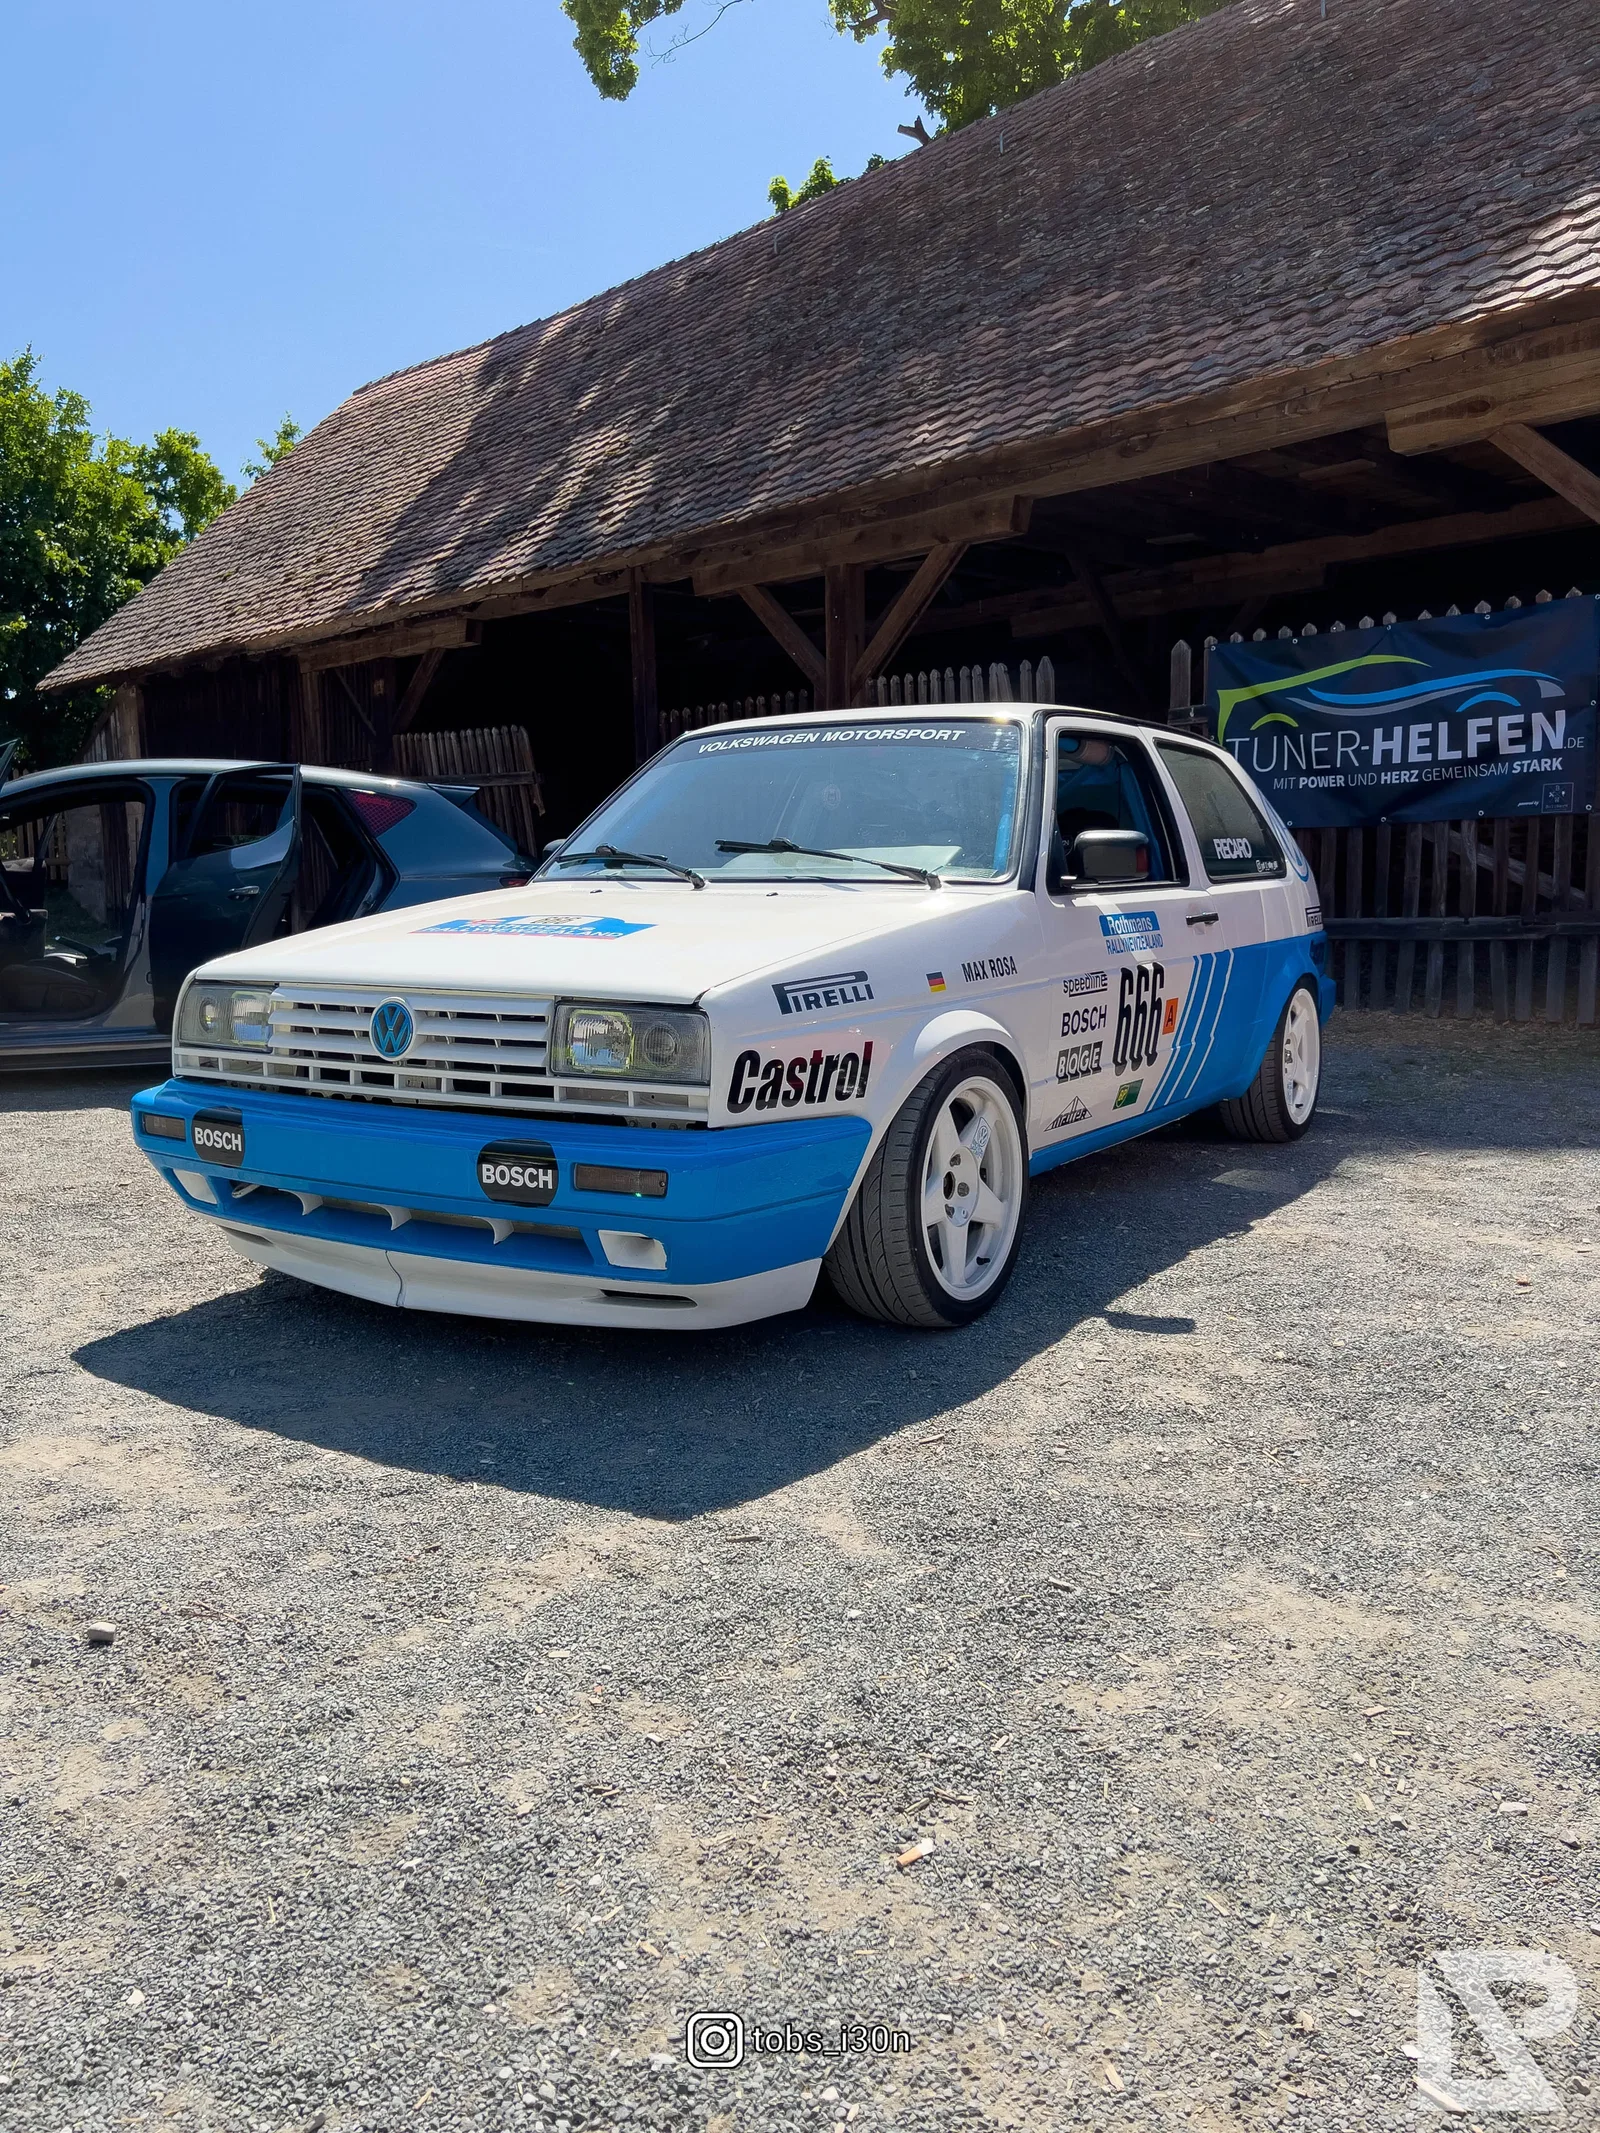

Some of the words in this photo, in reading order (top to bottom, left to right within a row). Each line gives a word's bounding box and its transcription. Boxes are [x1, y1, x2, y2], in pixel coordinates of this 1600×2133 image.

[698, 732, 820, 754] VOLKSWAGEN
[821, 729, 966, 743] MOTORSPORT
[1273, 777, 1297, 790] MIT
[1299, 775, 1345, 789] POWER
[1347, 772, 1377, 786] UND
[1380, 769, 1419, 785] HERZ
[1422, 762, 1509, 782] GEMEINSAM
[1511, 757, 1563, 774] STARK
[1213, 838, 1252, 859] RECARO
[1106, 916, 1153, 935] Rothmans
[961, 960, 988, 983] MAX
[990, 956, 1018, 978] ROSA
[771, 970, 874, 1016] PIRELLI
[1063, 971, 1108, 997] speedline
[1061, 1005, 1107, 1037] BOSCH
[1112, 962, 1165, 1076] 666
[1165, 1006, 1174, 1027] A
[1056, 1043, 1102, 1081] BOGE
[727, 1041, 873, 1114] Castrol
[194, 1126, 242, 1152] BOSCH
[481, 1163, 553, 1190] BOSCH
